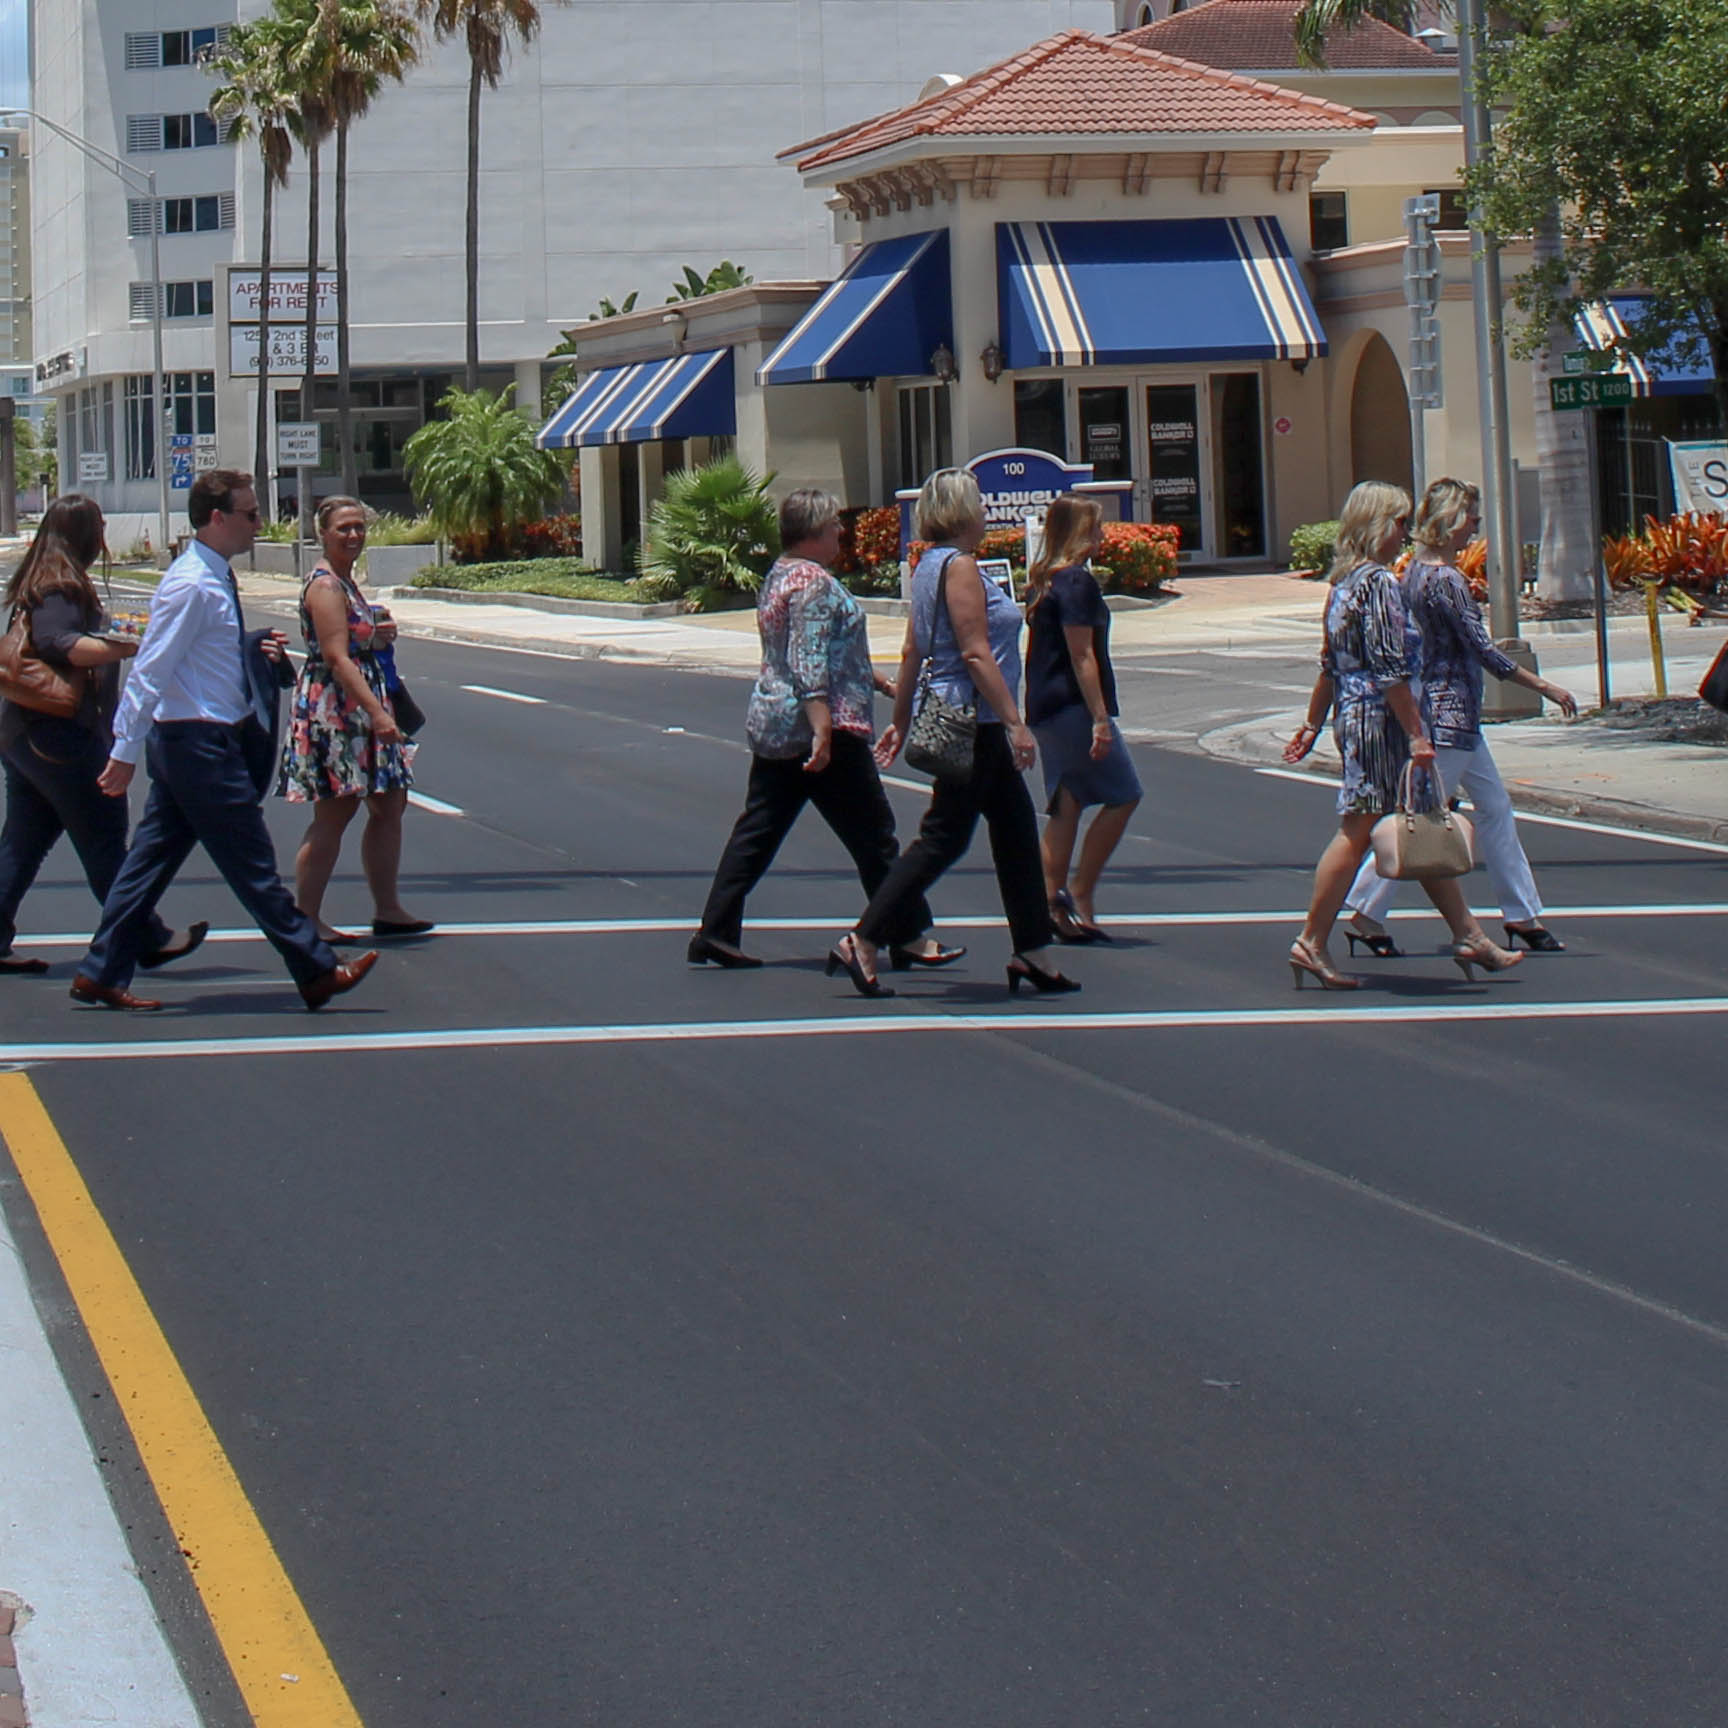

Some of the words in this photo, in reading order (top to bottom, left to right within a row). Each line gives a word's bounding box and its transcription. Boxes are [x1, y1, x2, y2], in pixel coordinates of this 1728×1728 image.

[286, 296, 328, 309] RET
[273, 330, 296, 342] 2nd
[299, 330, 335, 342] Seet
[272, 343, 282, 354] &
[287, 343, 295, 354] 3
[277, 355, 329, 367] 376-650
[1553, 382, 1575, 403] 1st
[1580, 380, 1599, 401] St
[1603, 382, 1630, 396] 1200
[175, 436, 189, 445] TO
[174, 454, 190, 467] 75
[1002, 462, 1025, 475] 100
[1689, 461, 1701, 499] THE
[984, 505, 1048, 522] ANKER
